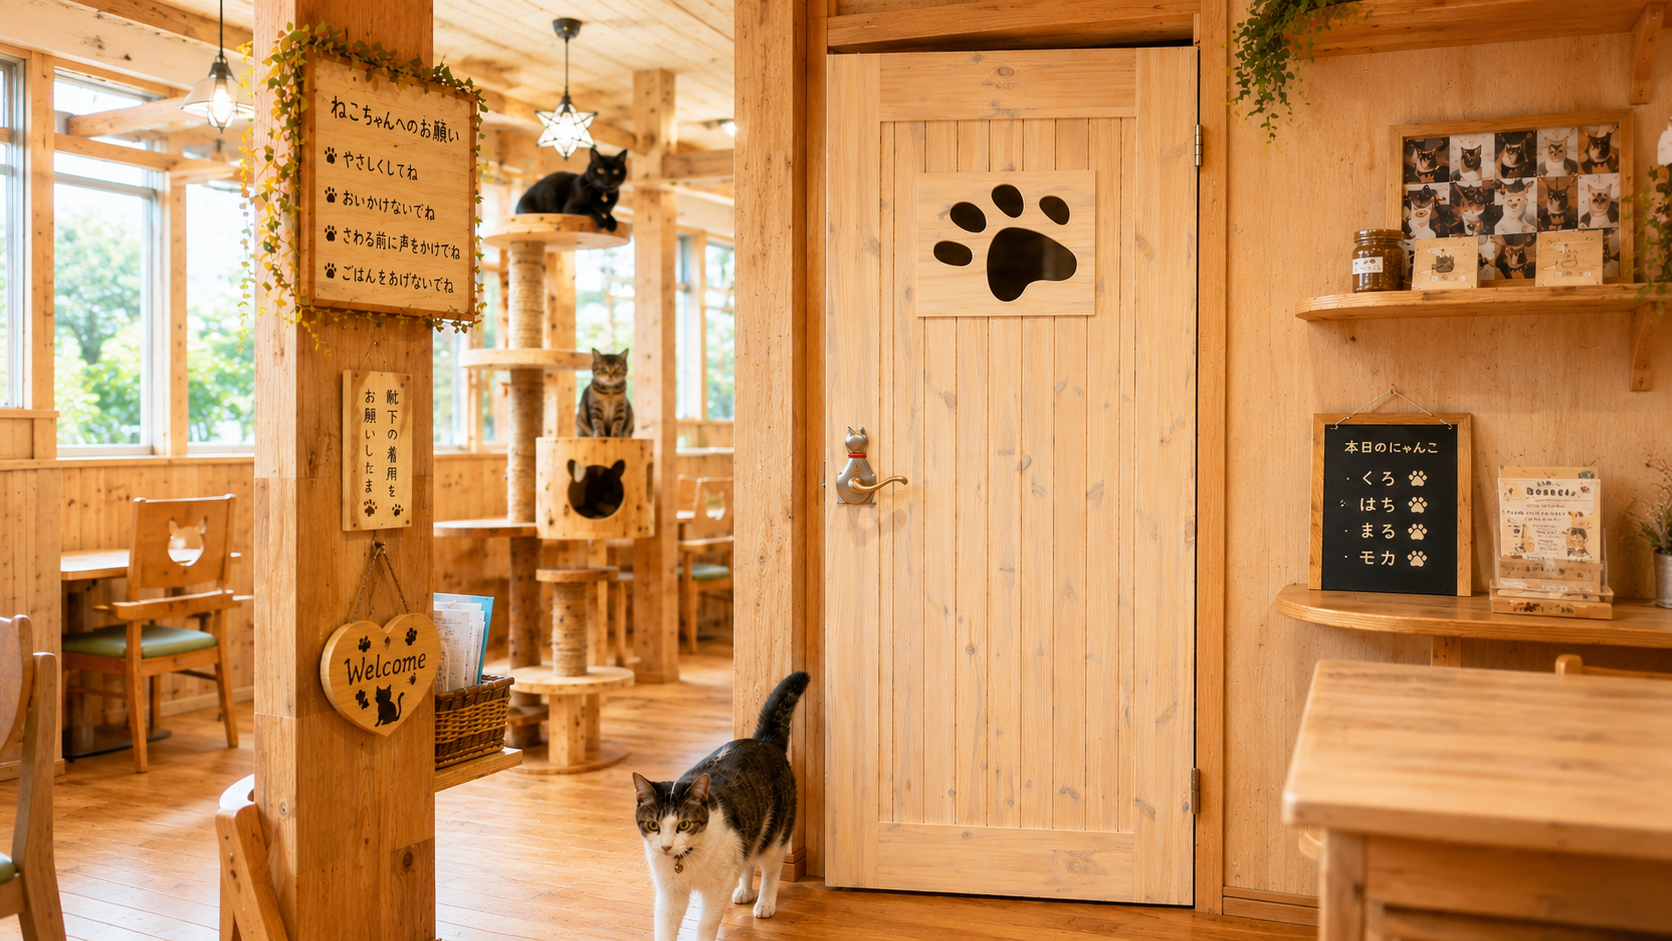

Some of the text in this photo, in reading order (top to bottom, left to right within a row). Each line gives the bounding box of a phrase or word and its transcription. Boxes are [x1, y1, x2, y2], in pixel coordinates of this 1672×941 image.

[331, 95, 459, 143] ねこちゃんへのお願い
[343, 151, 418, 181] やさしくしてね
[342, 190, 435, 221] おいかけないでね
[343, 227, 460, 260] さわる前に声をかけでね
[342, 265, 454, 294] ごはんをあげないでね
[385, 389, 399, 497] 靴下の着用を
[1344, 440, 1438, 454] 本日のにゃんこ
[344, 653, 426, 686] Welcome
